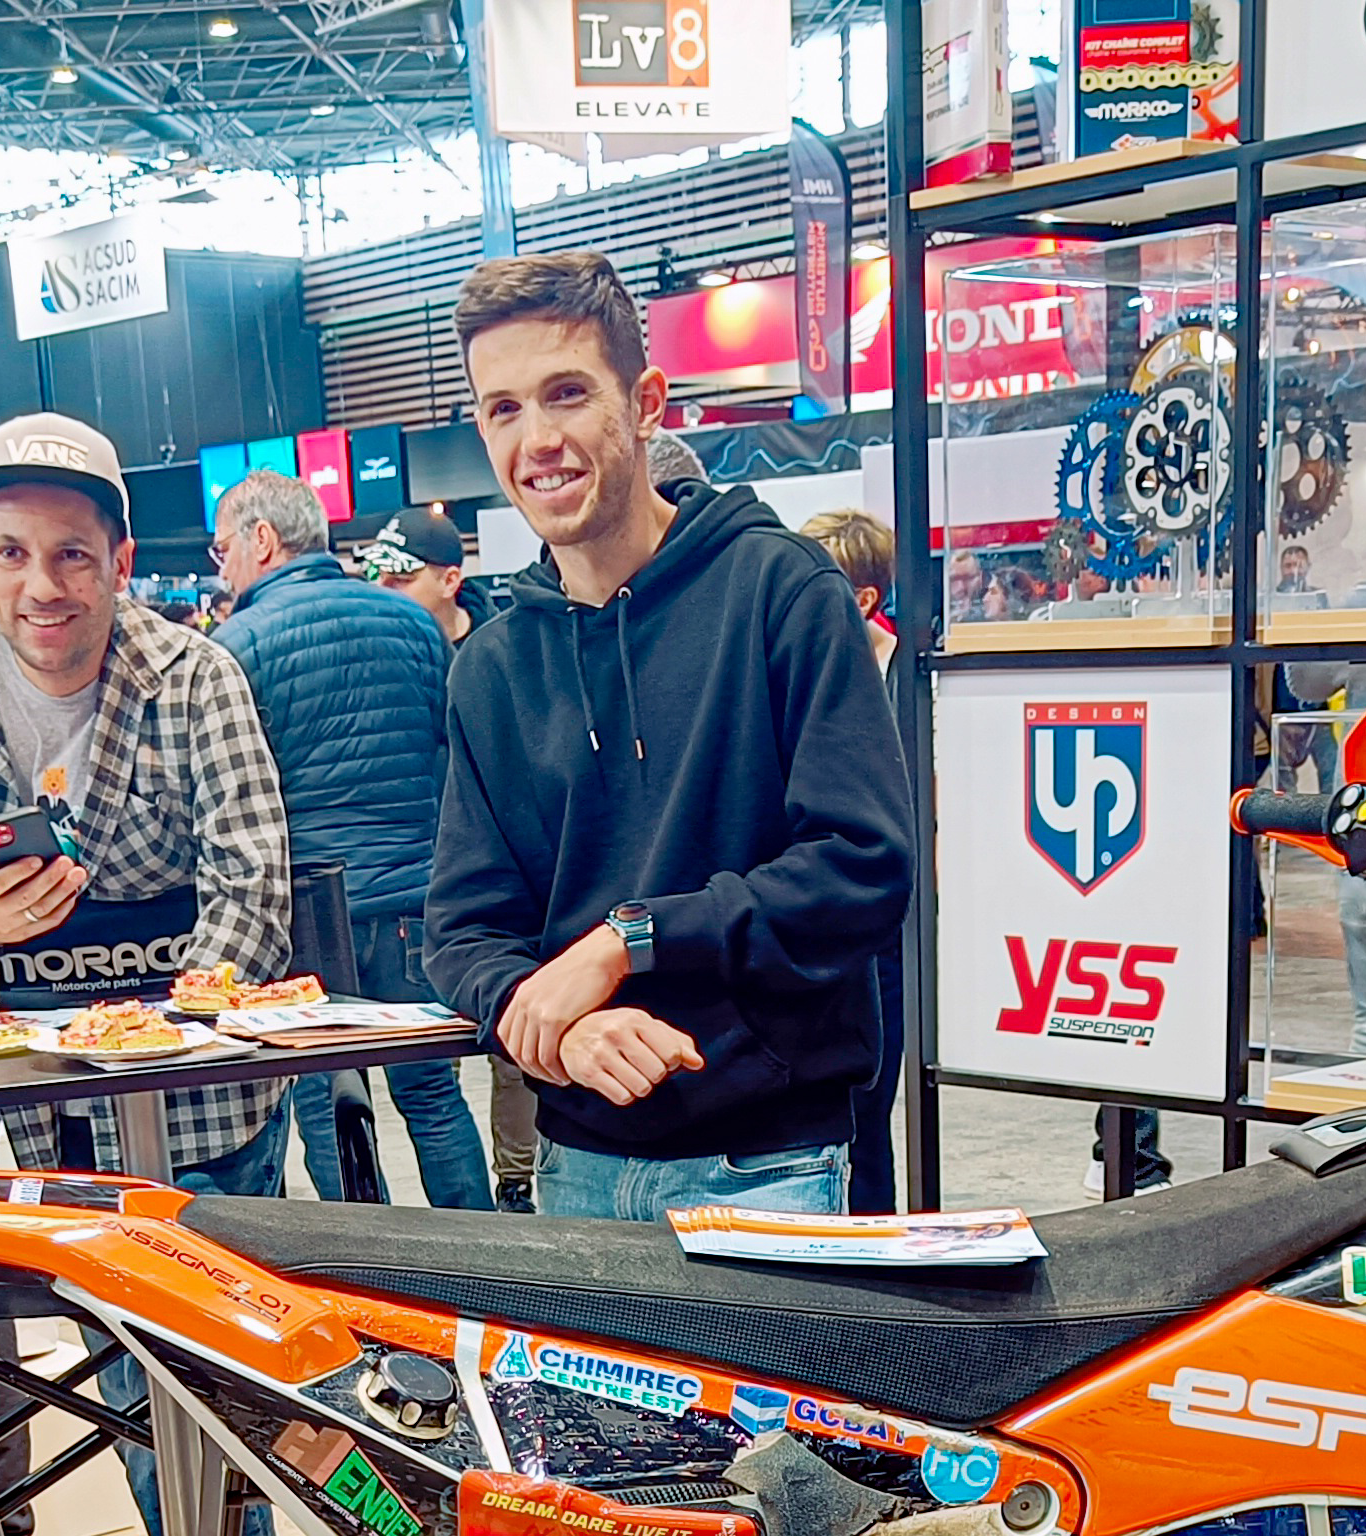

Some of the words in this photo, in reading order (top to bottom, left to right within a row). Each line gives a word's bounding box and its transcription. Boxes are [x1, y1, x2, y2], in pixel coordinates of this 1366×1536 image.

[576, 102, 711, 117] ELEVATE
[1097, 100, 1171, 120] MORACO
[83, 239, 137, 276] ACSUD
[85, 273, 141, 307] SACIM
[5, 434, 89, 471] VANS
[1026, 706, 1145, 720] DESIGN
[51, 979, 106, 996] Motorcycle
[108, 977, 141, 993] parts
[1048, 1016, 1155, 1039] SUSPENSION
[258, 1293, 293, 1315] 01
[537, 1348, 700, 1400] CHIMIREC
[540, 1368, 686, 1415] CENTRE-EST
[265, 1453, 307, 1486] CHARPENTE
[315, 1491, 361, 1528] COUVERTURE
[481, 1490, 558, 1520] DREAM.
[560, 1510, 619, 1535] DARE.
